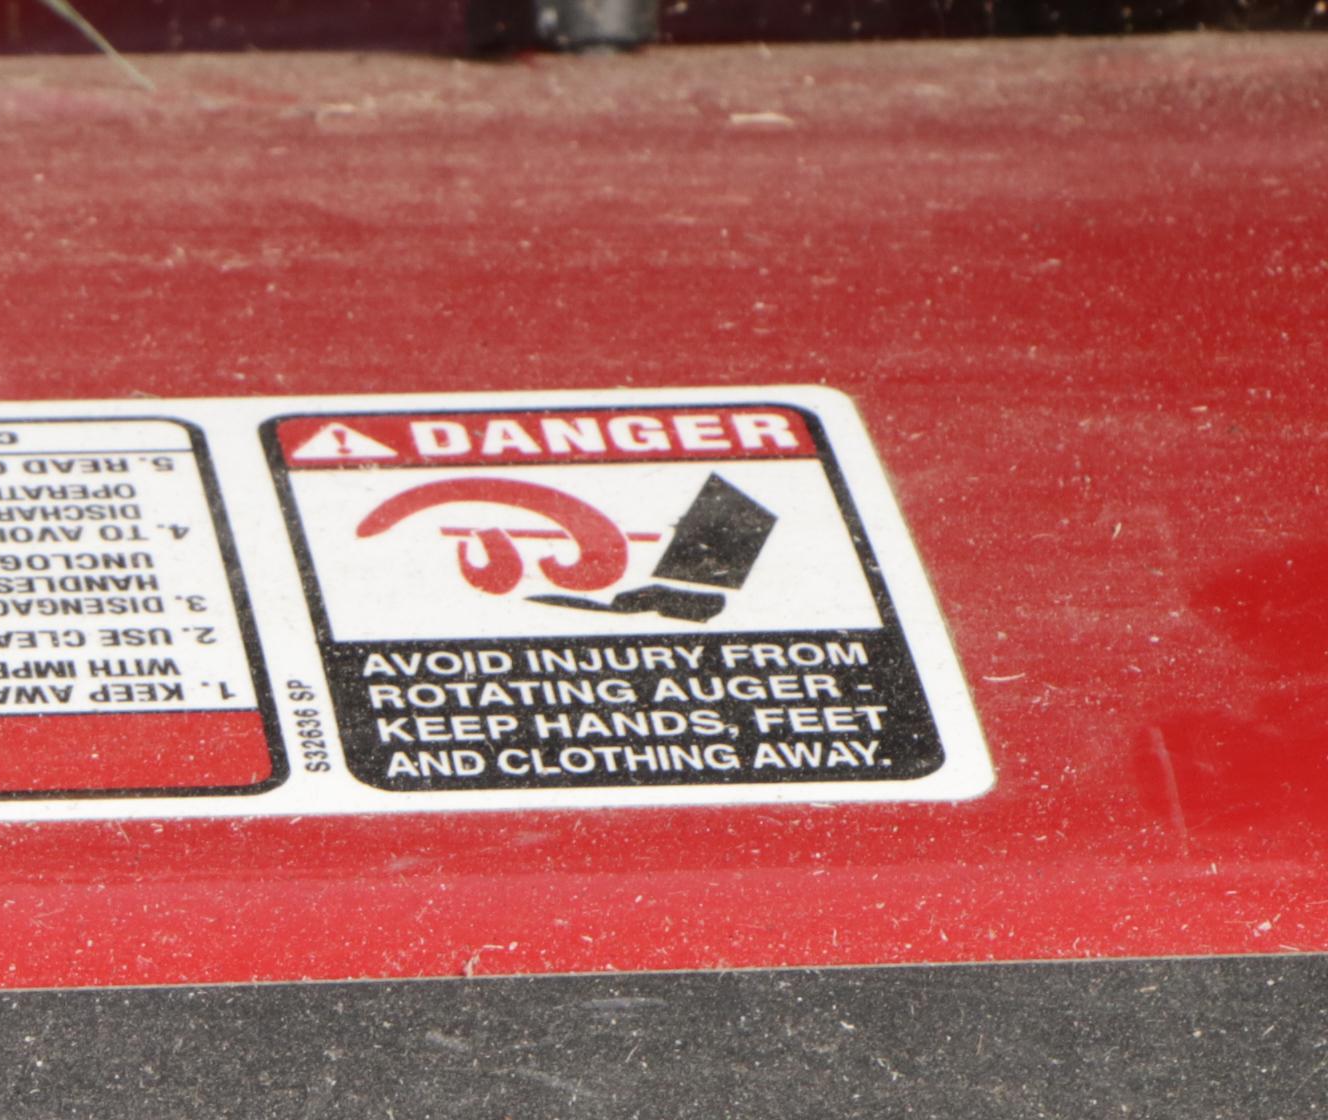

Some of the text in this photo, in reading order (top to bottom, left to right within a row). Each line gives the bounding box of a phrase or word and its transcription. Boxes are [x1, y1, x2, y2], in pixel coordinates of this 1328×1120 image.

[410, 412, 800, 460] DANGER
[23, 459, 128, 474] READ
[141, 457, 173, 471] 5.
[99, 526, 143, 541] TO
[159, 525, 188, 539] 4.
[176, 596, 206, 612] 3.
[100, 628, 172, 646] USE
[184, 627, 215, 644] 2.
[88, 659, 180, 677] WITH
[362, 642, 869, 677] AVOID INJURY FROM
[89, 683, 184, 702] KEEP
[202, 682, 234, 700] 1.
[369, 679, 636, 708] ROTATING
[653, 673, 842, 702] AUGER
[286, 680, 331, 772] S32636 SP
[376, 706, 888, 742] KEEP HANDS, FEET
[387, 740, 892, 778] AND CLOTHING AWAY.
